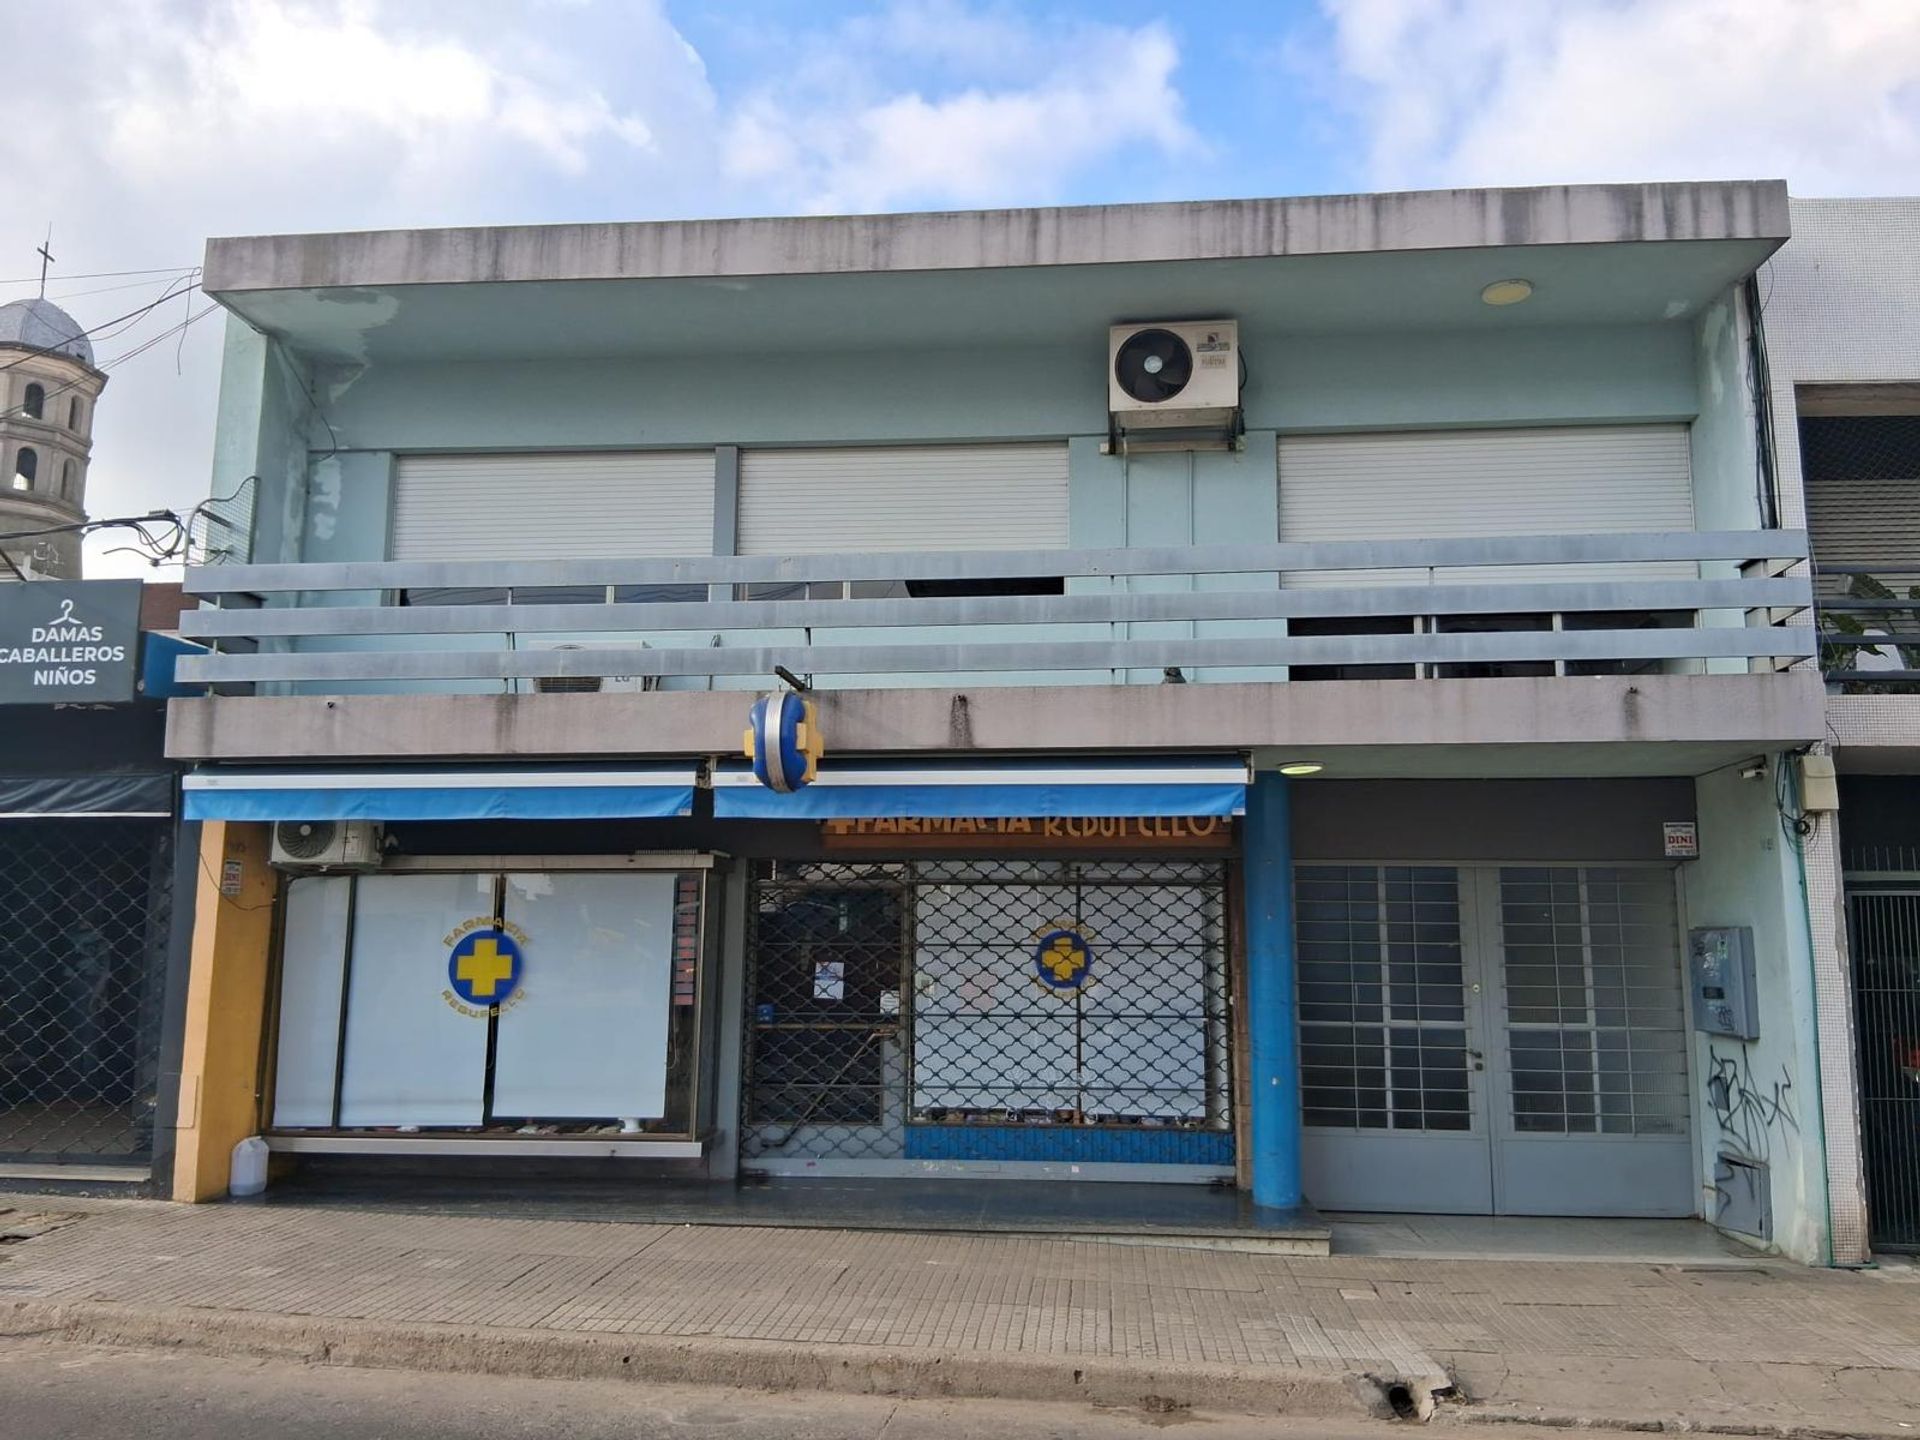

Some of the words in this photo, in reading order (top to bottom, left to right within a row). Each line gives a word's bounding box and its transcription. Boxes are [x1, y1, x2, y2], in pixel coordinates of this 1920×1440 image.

[32, 626, 103, 643] DAMAS
[0, 646, 125, 663] CABALLEROS
[33, 666, 97, 685] NIÑOS
[1667, 835, 1693, 845] DINI
[442, 915, 529, 947] FARMACIA
